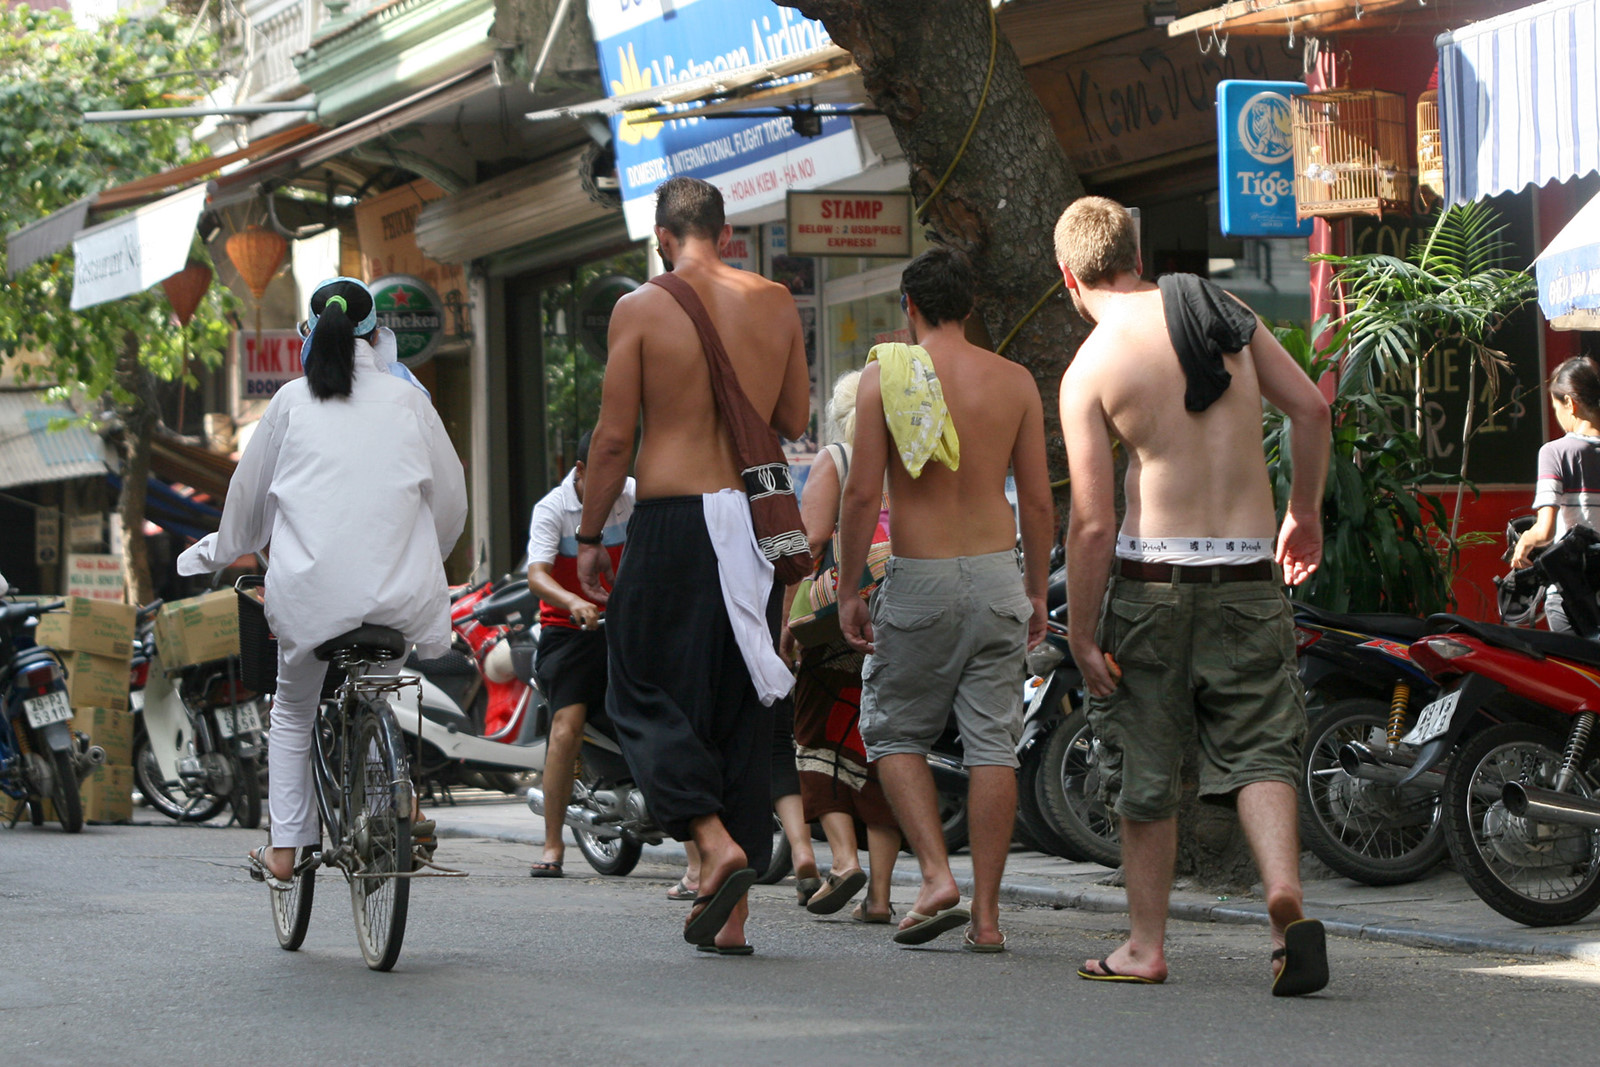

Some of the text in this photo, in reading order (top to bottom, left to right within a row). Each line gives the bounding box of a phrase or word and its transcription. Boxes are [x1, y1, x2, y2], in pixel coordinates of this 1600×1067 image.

[627, 157, 667, 188] DOMESTIC
[673, 137, 735, 174] INTERNATIONAL
[735, 127, 764, 155] FLIGHT
[730, 178, 757, 201] HOAN
[757, 169, 778, 193] KIEM
[798, 158, 816, 179] NOI
[821, 200, 883, 219] STAMP
[798, 224, 833, 234] BELOW
[842, 226, 849, 234] 2
[850, 225, 902, 236] USD/PIECE
[827, 237, 877, 248] EXPRESS!
